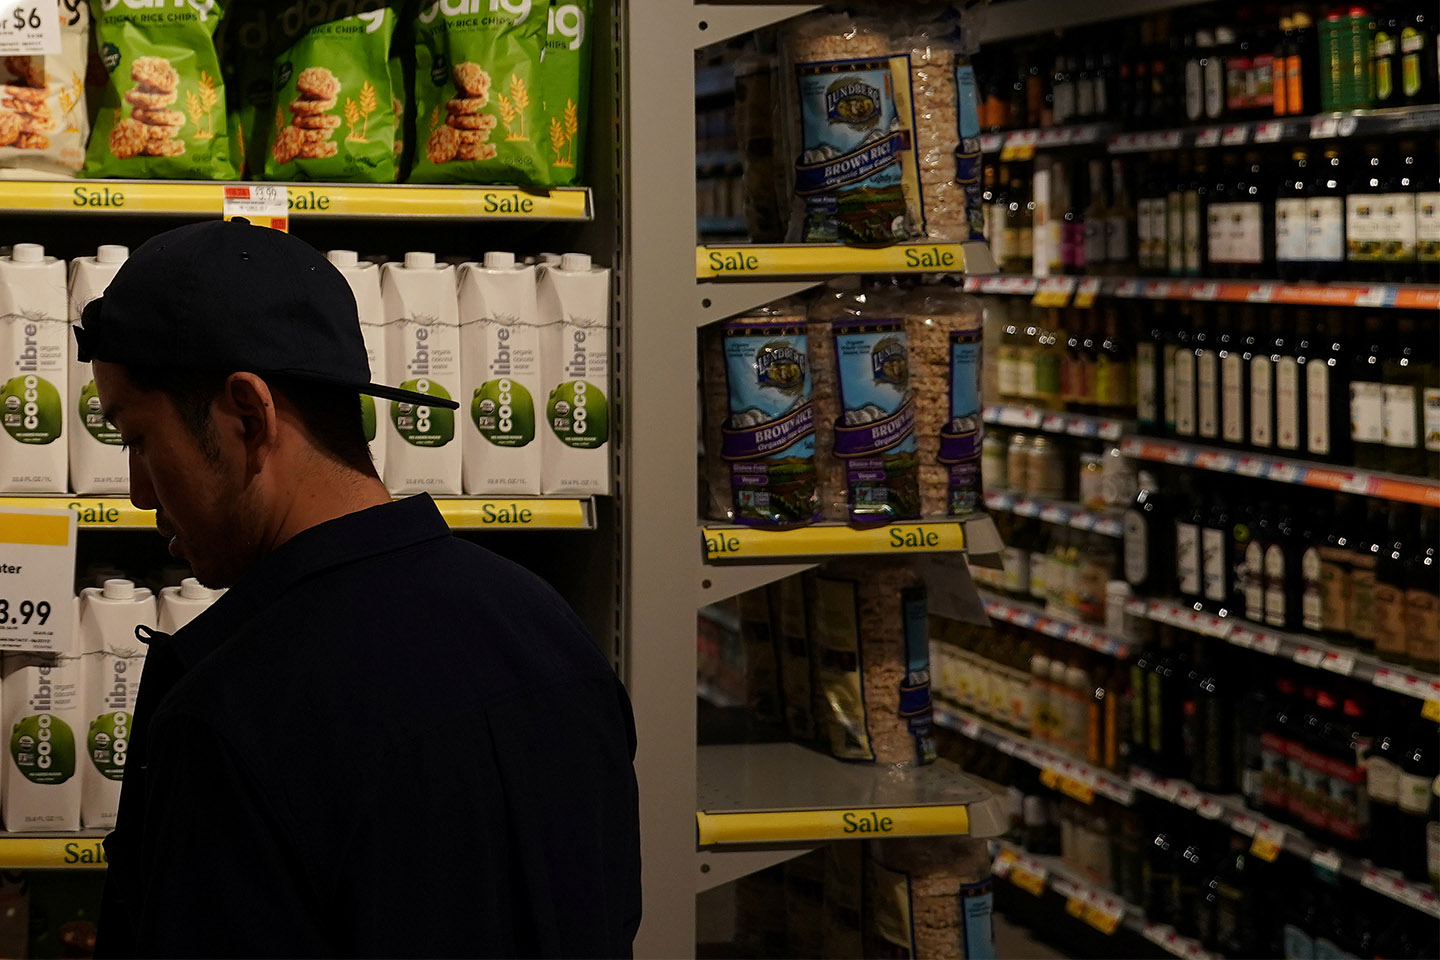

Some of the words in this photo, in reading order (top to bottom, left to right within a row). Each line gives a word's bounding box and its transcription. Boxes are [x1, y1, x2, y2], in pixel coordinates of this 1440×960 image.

[13, 6, 42, 30] $6
[824, 151, 869, 178] BROWN
[72, 186, 125, 207] Sale
[484, 193, 534, 214] Sale
[709, 250, 758, 272] Sale
[905, 247, 954, 269] Sale
[15, 324, 38, 371] libre
[407, 327, 429, 375] libre
[489, 328, 510, 375] libre
[565, 329, 586, 378] libre
[24, 374, 39, 430] coco
[416, 378, 431, 433] coo
[498, 378, 512, 433] coco
[573, 380, 587, 434] coco
[67, 502, 119, 525] Sale
[481, 503, 532, 526] Sale
[705, 534, 741, 553] ale
[889, 528, 939, 548] Sale
[29, 663, 52, 711] libre
[104, 660, 127, 709] libre
[37, 713, 52, 769] coco
[113, 711, 127, 766] coco
[842, 812, 894, 834] Sale
